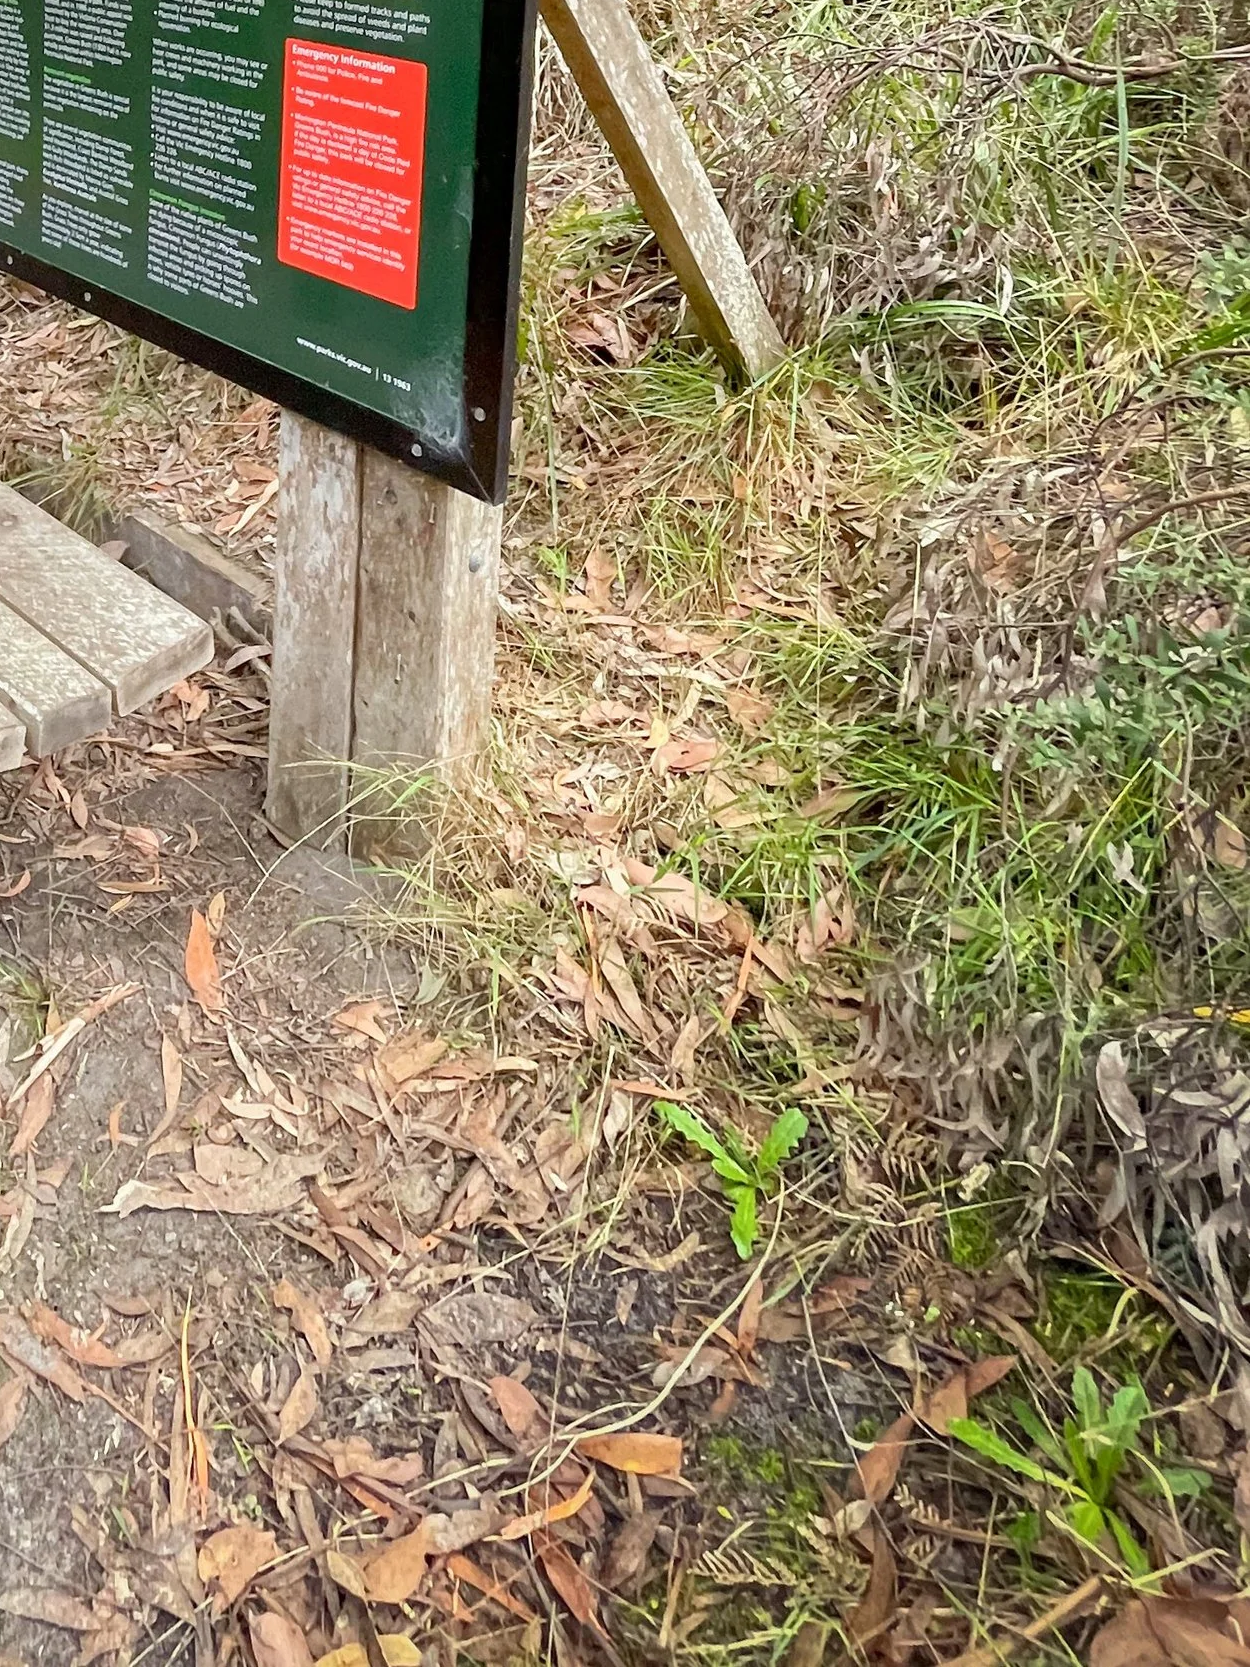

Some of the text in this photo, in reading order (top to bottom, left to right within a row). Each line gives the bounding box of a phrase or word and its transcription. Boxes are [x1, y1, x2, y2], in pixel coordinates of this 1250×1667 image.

[294, 5, 300, 13] to
[302, 7, 320, 16] avoid
[322, 9, 332, 18] the
[334, 12, 357, 22] spread
[368, 18, 390, 29] weeds
[392, 22, 406, 31] and
[408, 24, 427, 35] plant
[335, 0, 342, 9] to
[344, 2, 370, 14] formed
[371, 6, 392, 17] tracks
[394, 11, 408, 20] and
[409, 13, 430, 23] paths
[321, 20, 334, 30] and
[335, 24, 363, 35] preserve
[292, 44, 395, 74] Emergency Information
[296, 337, 411, 392] www.parks.vic.gov.au 13 1963
